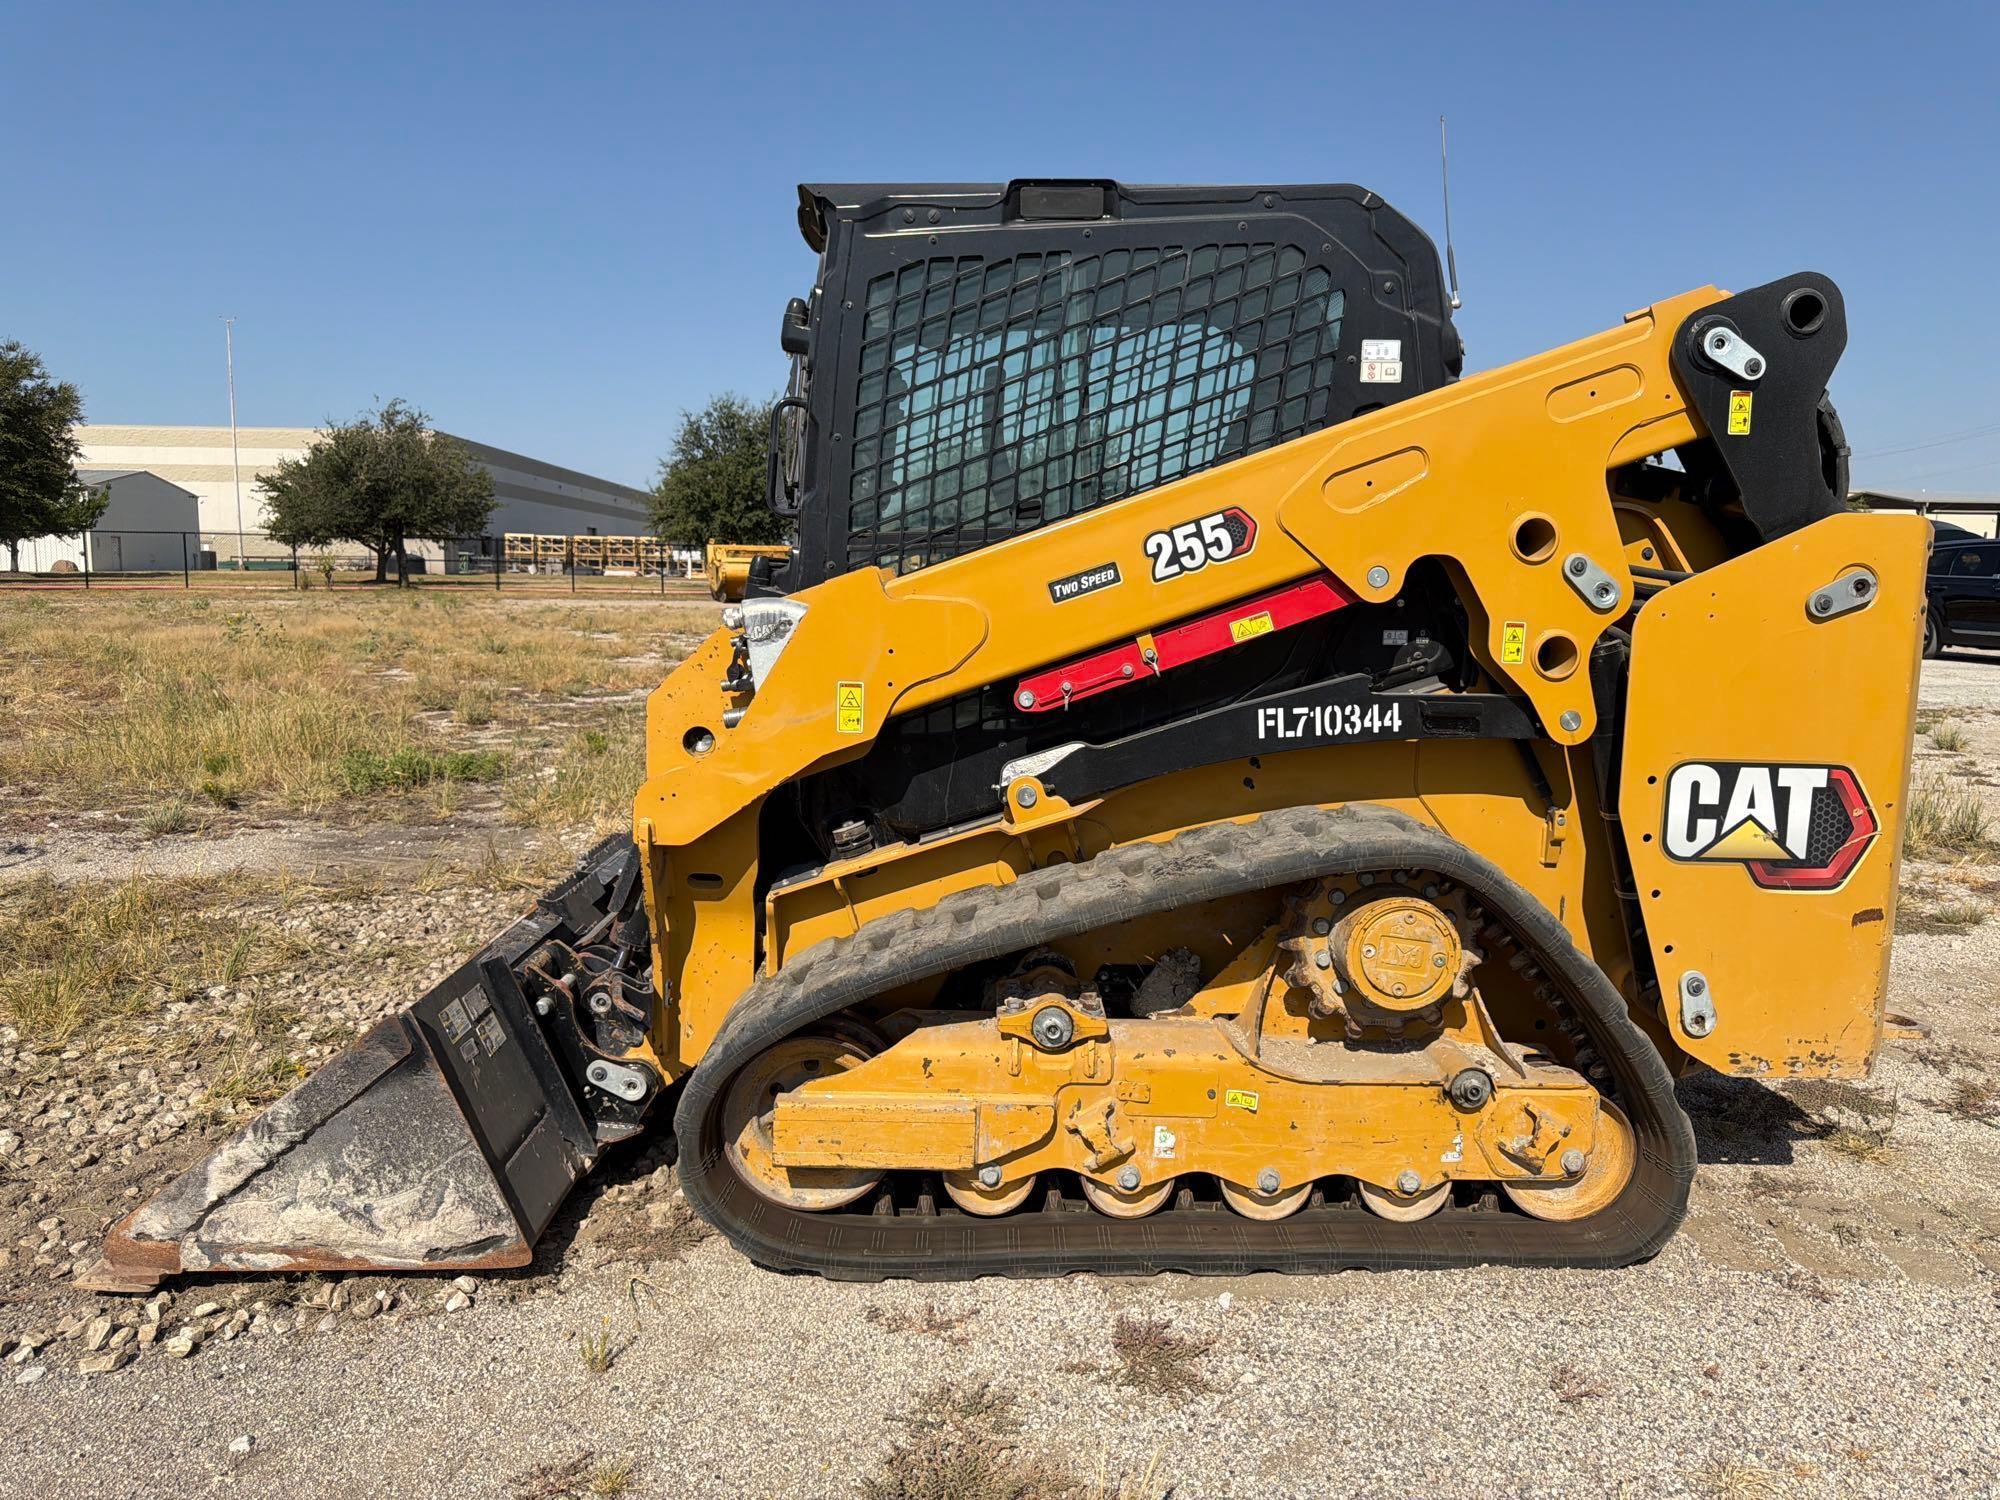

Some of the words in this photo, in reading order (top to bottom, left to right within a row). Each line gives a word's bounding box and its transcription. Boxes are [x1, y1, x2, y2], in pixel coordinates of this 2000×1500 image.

[1146, 513, 1234, 580] 255
[1257, 702, 1403, 740] FL710344
[1666, 764, 1829, 860] CAT
